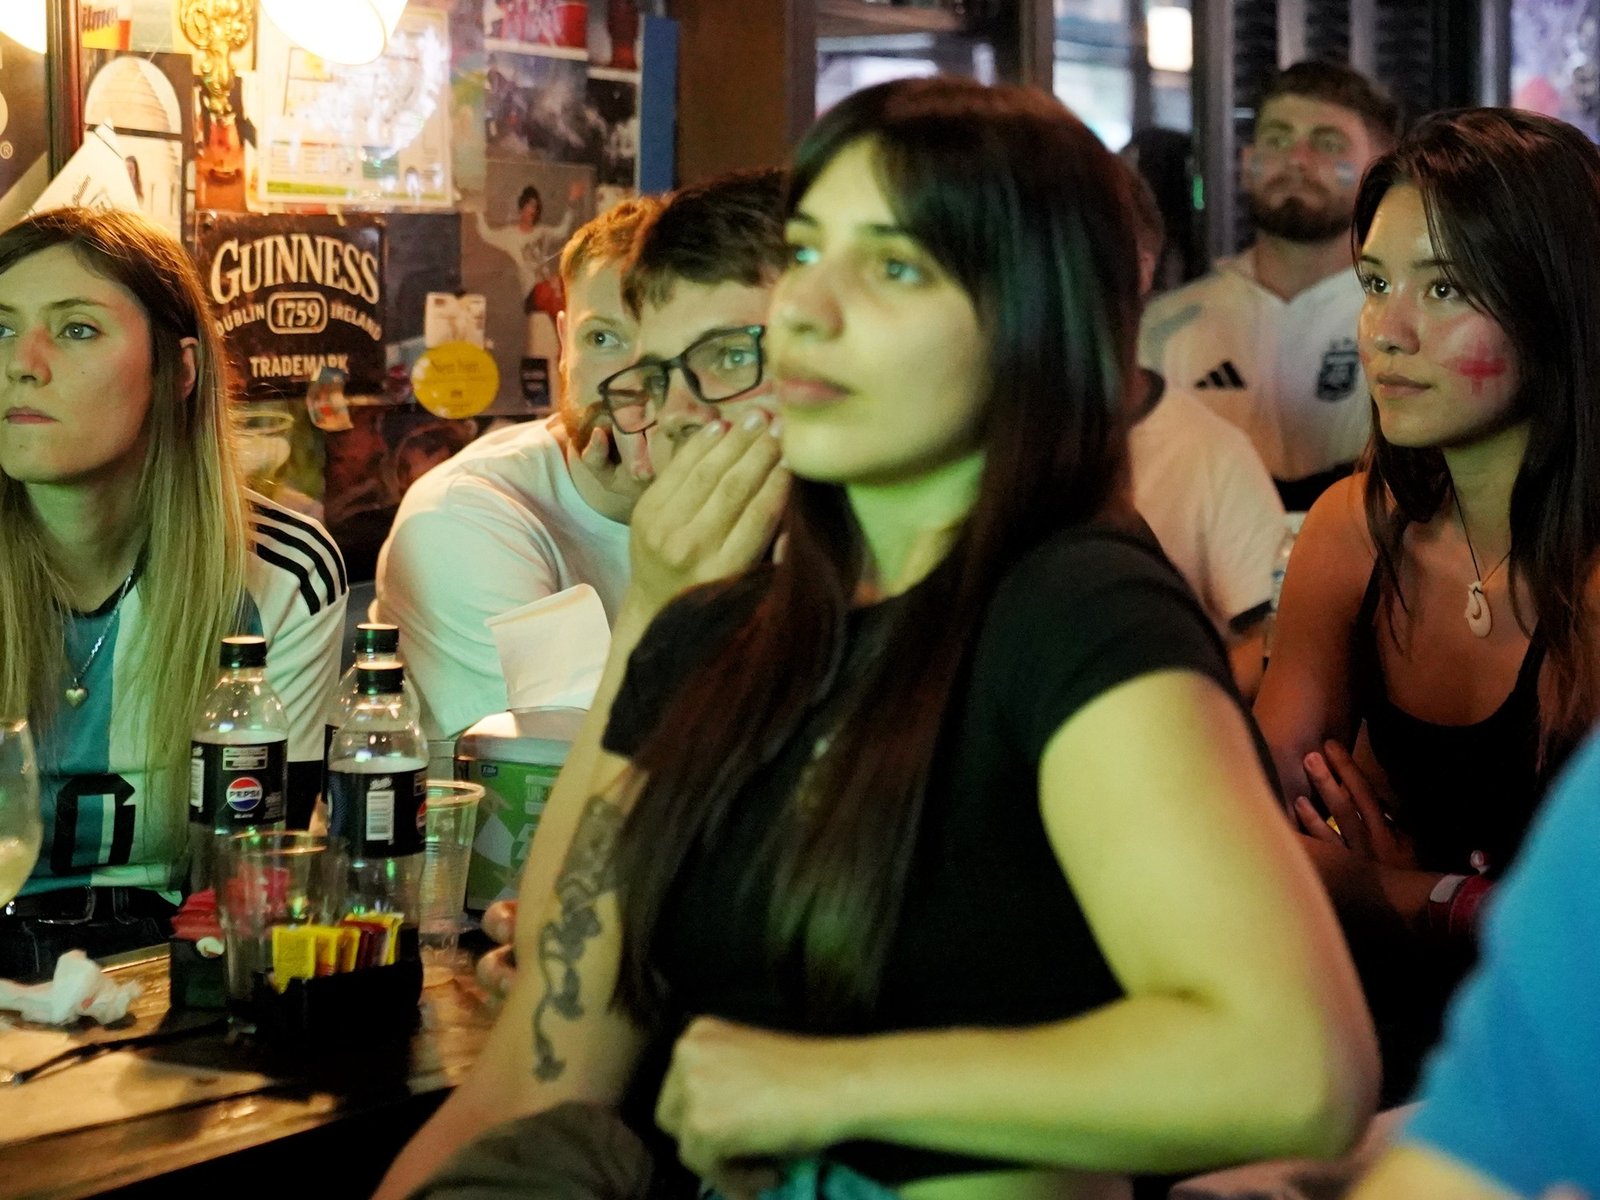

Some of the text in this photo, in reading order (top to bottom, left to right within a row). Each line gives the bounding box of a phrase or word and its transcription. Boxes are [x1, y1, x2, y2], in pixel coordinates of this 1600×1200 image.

[211, 233, 380, 305] GUINNESS
[215, 303, 382, 341] DUBLIN 1759 IRELAND
